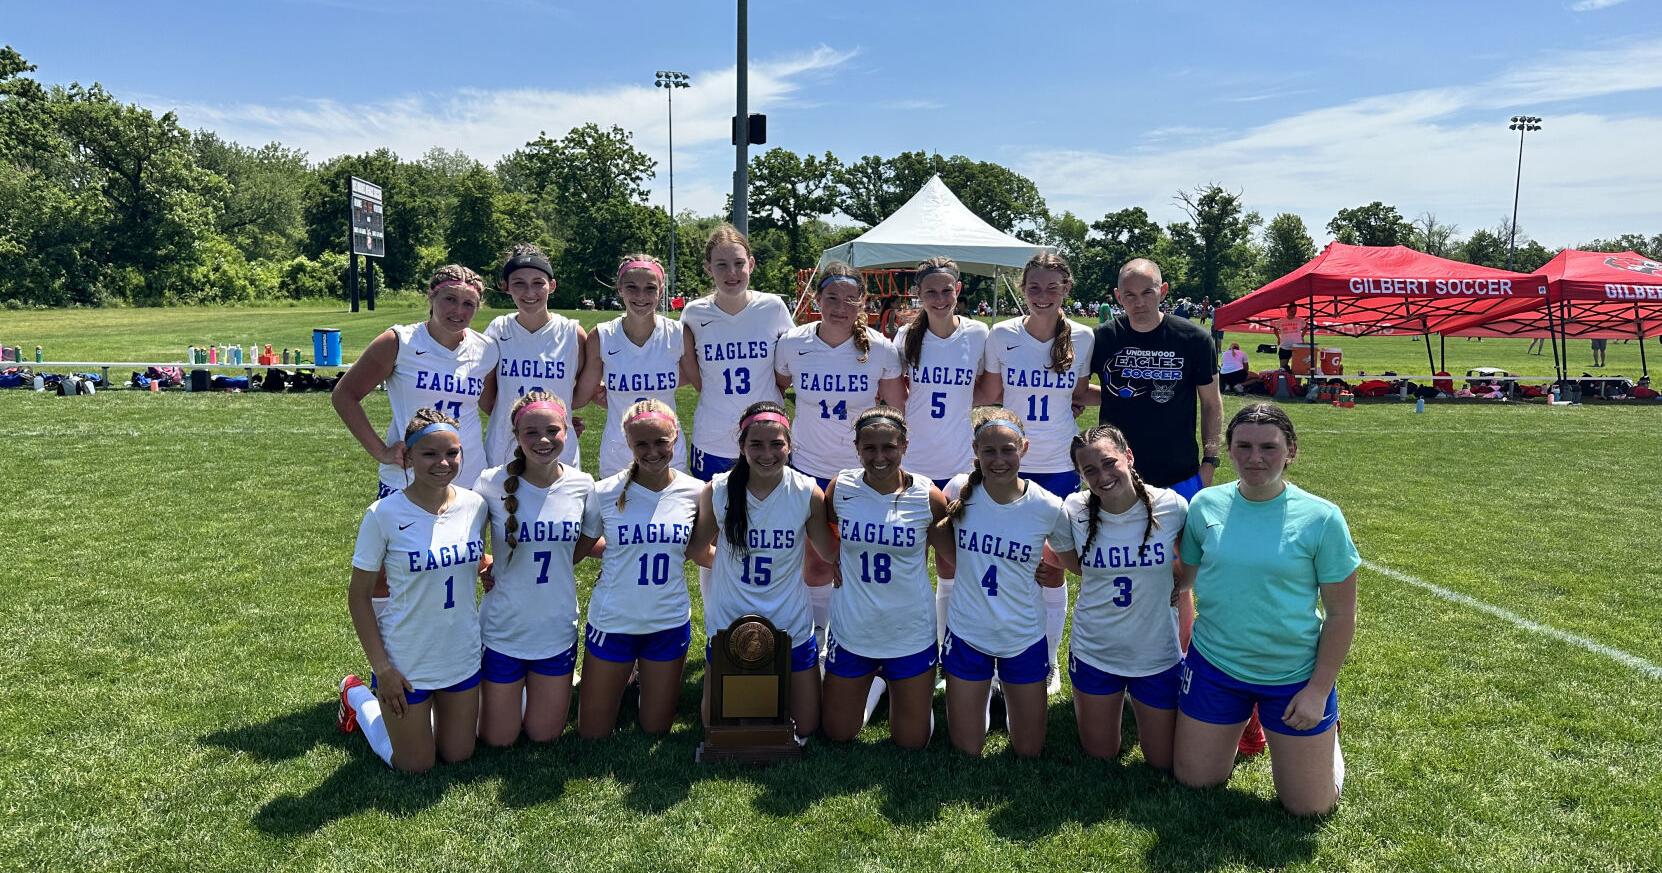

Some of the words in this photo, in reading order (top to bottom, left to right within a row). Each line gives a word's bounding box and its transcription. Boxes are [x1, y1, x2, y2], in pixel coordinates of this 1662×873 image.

[1349, 277, 1430, 294] GILBERT
[1435, 278, 1513, 295] SOCCER
[703, 340, 768, 361] EAGLES
[1115, 356, 1184, 369] EAGLES
[1126, 349, 1175, 357] UNDERWOOD
[501, 358, 565, 379] EAGLES
[608, 371, 676, 391] EAGLES
[722, 367, 751, 395] 13
[912, 366, 973, 386] EAGLES
[1007, 367, 1075, 389] EAGLES
[1121, 368, 1182, 380] SOCCER
[415, 370, 483, 396] EAGLES
[800, 372, 868, 392] EAGLES
[819, 399, 848, 420] 14
[930, 391, 947, 419] 5
[1026, 394, 1049, 422] 11
[617, 523, 690, 546] EAGLES
[748, 528, 795, 549] GLES
[841, 519, 916, 547] EAGLES
[958, 528, 1032, 563] EAGLES
[408, 540, 483, 572] EAGLES
[533, 551, 552, 584] 7
[859, 551, 892, 584] 18
[1081, 542, 1165, 568] EAGLES
[637, 552, 670, 586] 10
[740, 555, 773, 586] 15
[981, 564, 998, 597] 4
[443, 575, 455, 610] 1
[1112, 576, 1132, 608] 3
